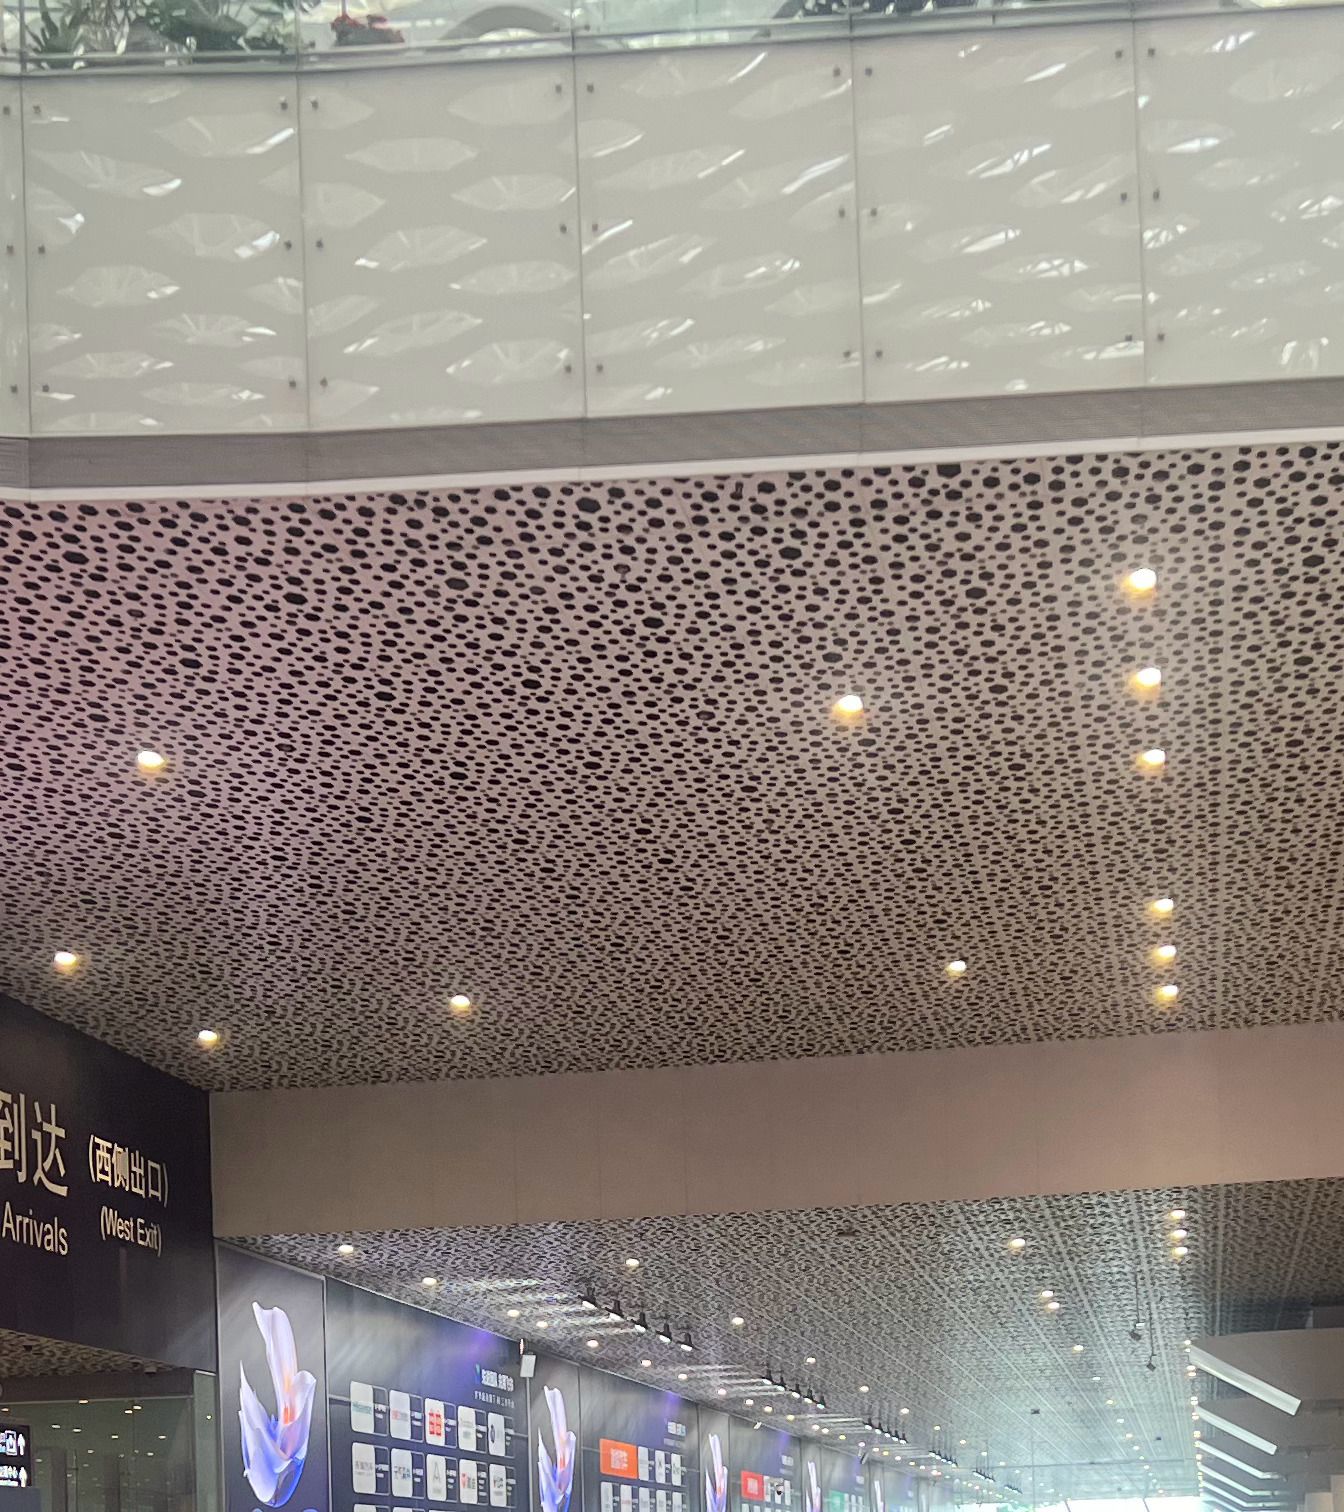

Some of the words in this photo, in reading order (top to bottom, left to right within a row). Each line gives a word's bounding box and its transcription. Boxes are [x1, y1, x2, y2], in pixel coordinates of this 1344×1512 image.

[2, 1201, 69, 1256] Arrivals
[100, 1205, 134, 1245] (West
[137, 1217, 162, 1257] Exit)
